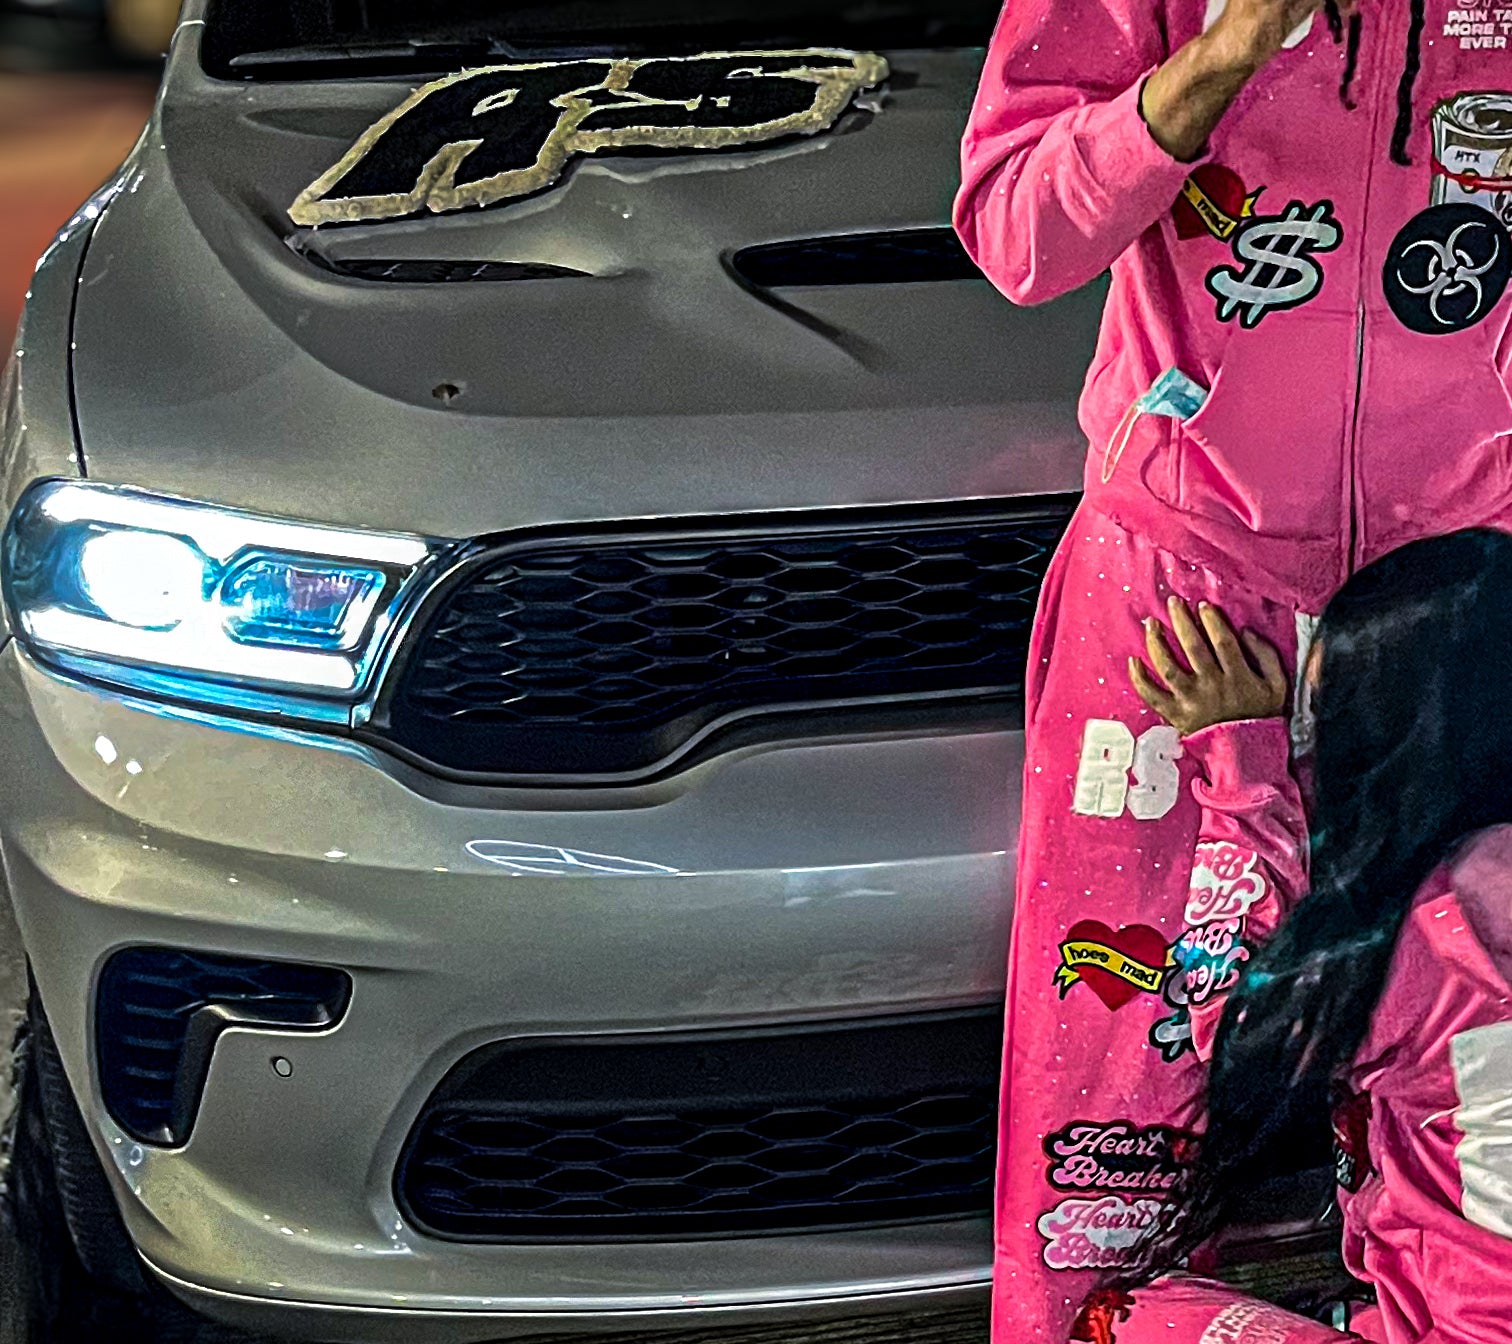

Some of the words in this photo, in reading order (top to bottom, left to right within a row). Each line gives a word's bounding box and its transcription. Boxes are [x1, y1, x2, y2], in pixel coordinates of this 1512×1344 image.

[1447, 10, 1488, 23] PAIN
[1443, 23, 1495, 37] MORE
[1459, 36, 1507, 50] EVER
[1071, 718, 1184, 820] RS
[1120, 961, 1158, 987] mad
[1053, 1126, 1166, 1156] Heart
